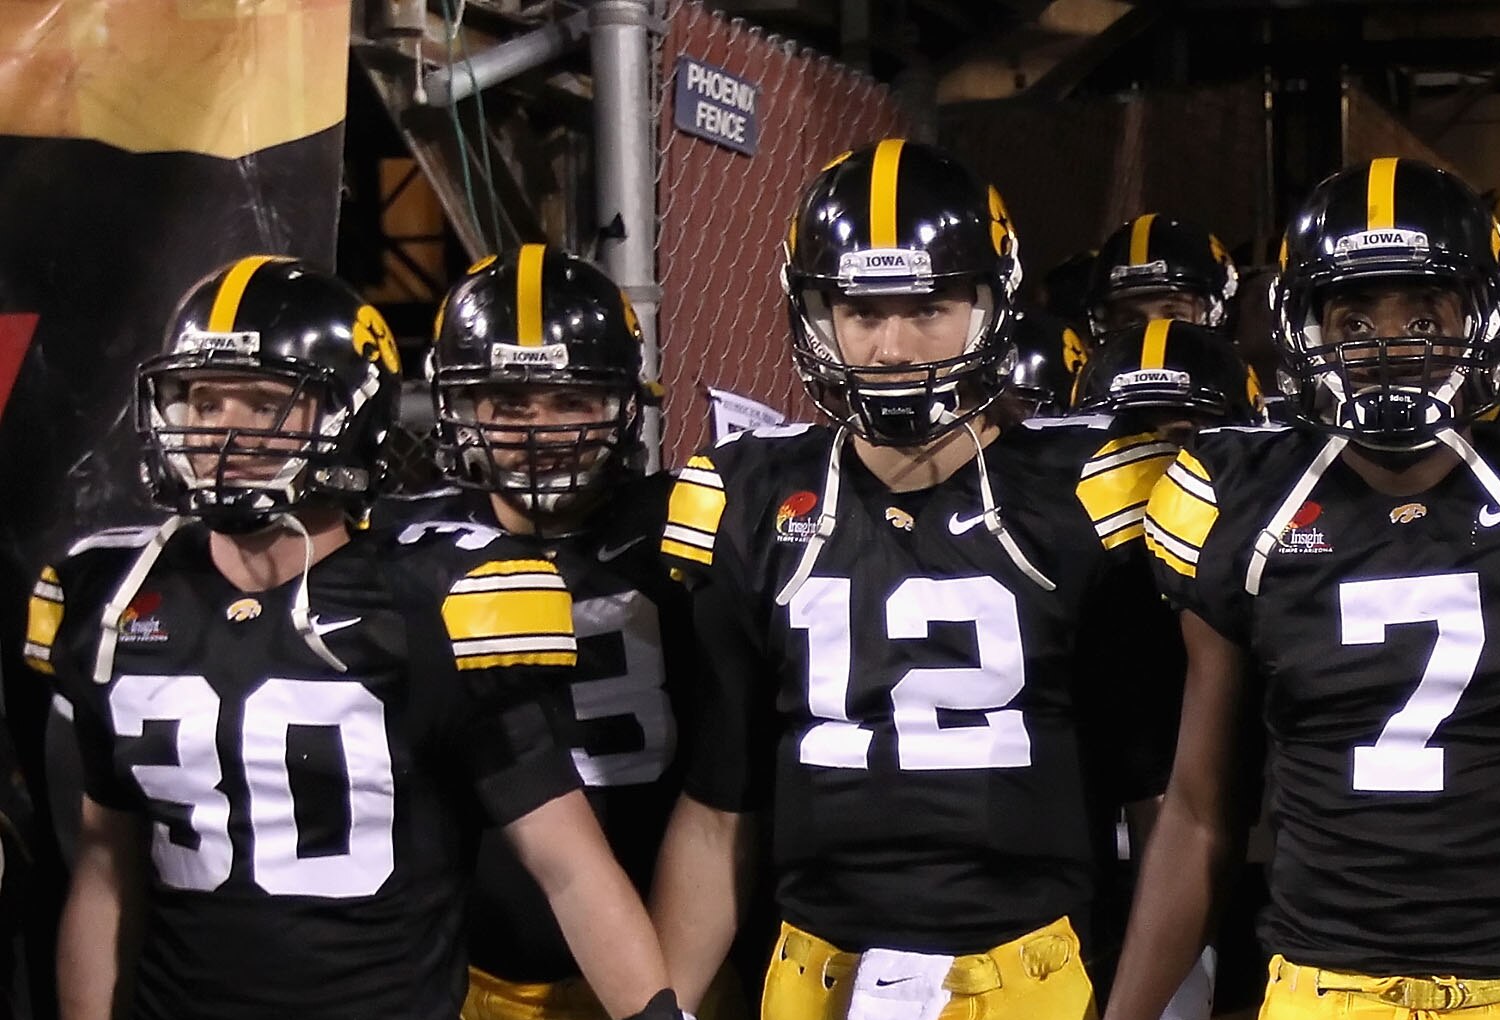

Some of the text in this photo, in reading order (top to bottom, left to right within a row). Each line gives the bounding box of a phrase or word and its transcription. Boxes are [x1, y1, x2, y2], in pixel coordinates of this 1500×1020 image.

[687, 62, 756, 114] PHOENIX
[696, 101, 747, 143] FENCE
[1363, 233, 1404, 245] IOWA
[866, 256, 905, 267] IOWA
[513, 352, 548, 361] IOWA
[1135, 373, 1169, 382] IOWA
[1291, 527, 1325, 549] Insight
[788, 574, 1031, 771] 12
[1339, 572, 1485, 792] 7
[109, 674, 395, 898] 30
